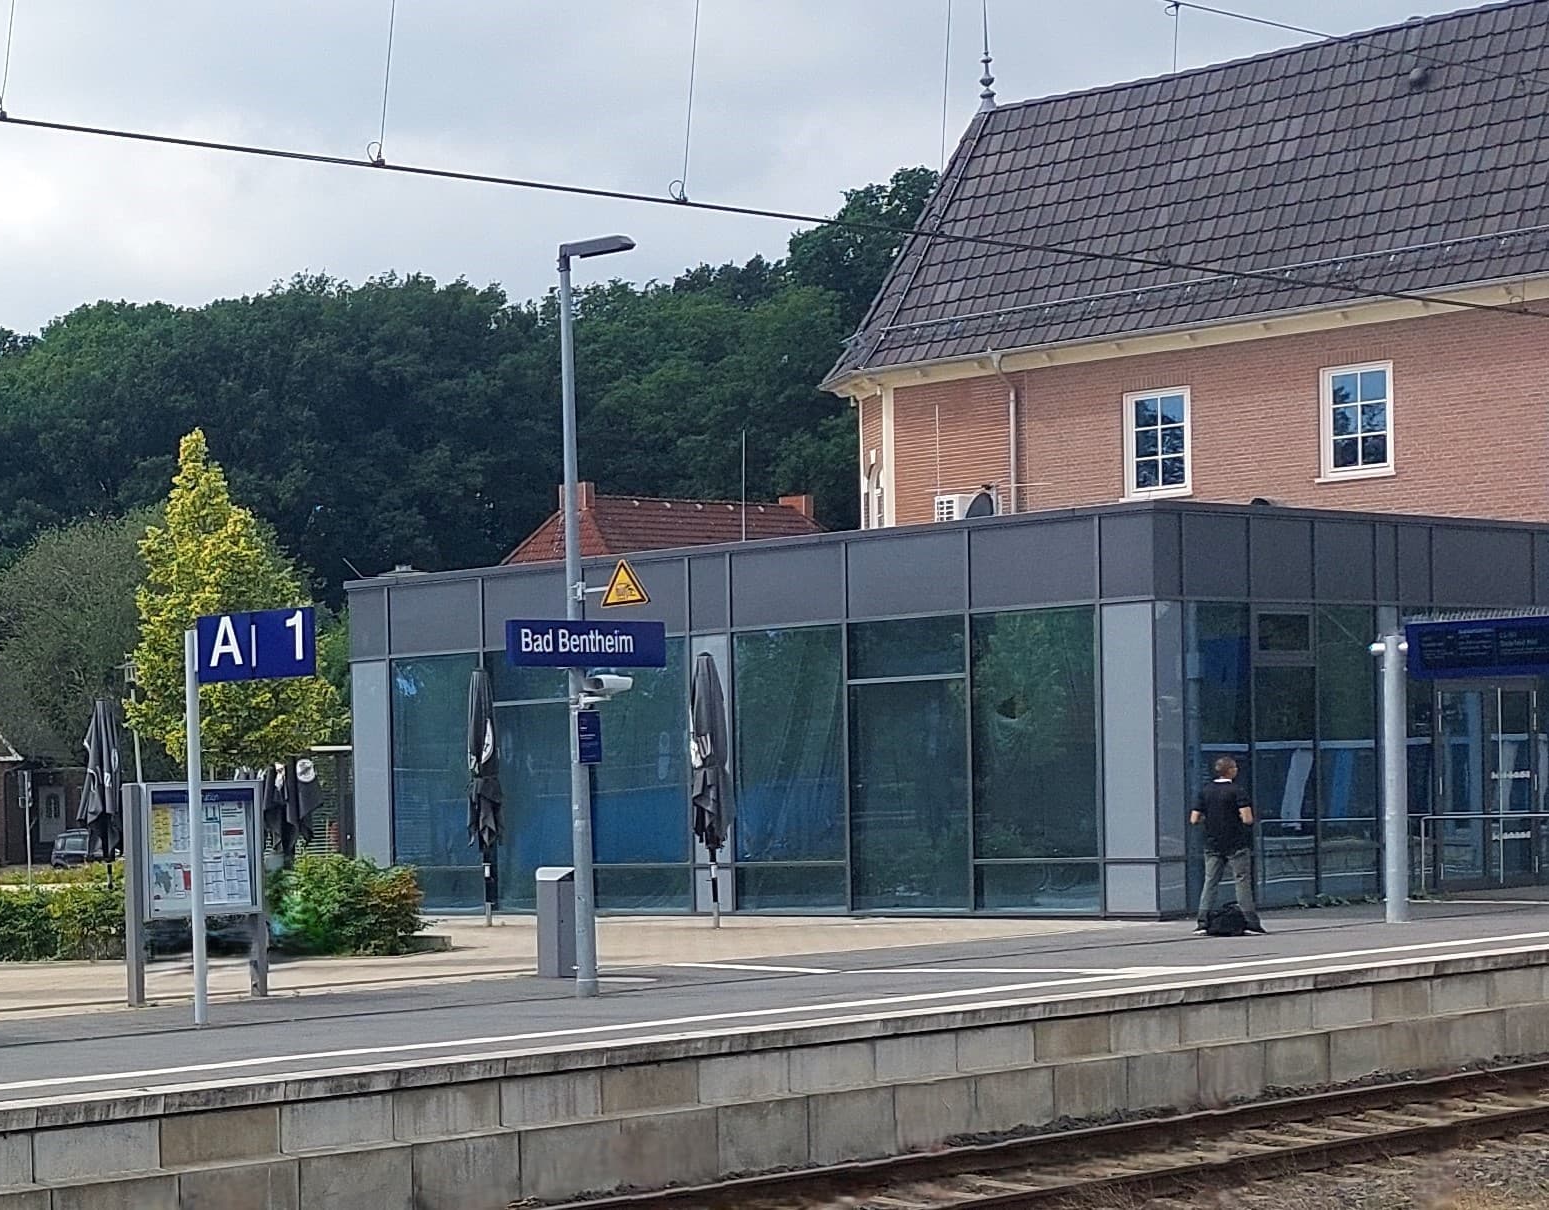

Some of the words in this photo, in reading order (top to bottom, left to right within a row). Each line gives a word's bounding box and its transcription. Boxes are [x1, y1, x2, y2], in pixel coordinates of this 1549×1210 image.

[209, 615, 244, 667] A
[285, 609, 304, 660] 1
[520, 628, 553, 652] Bad
[558, 628, 634, 653] Bentheim
